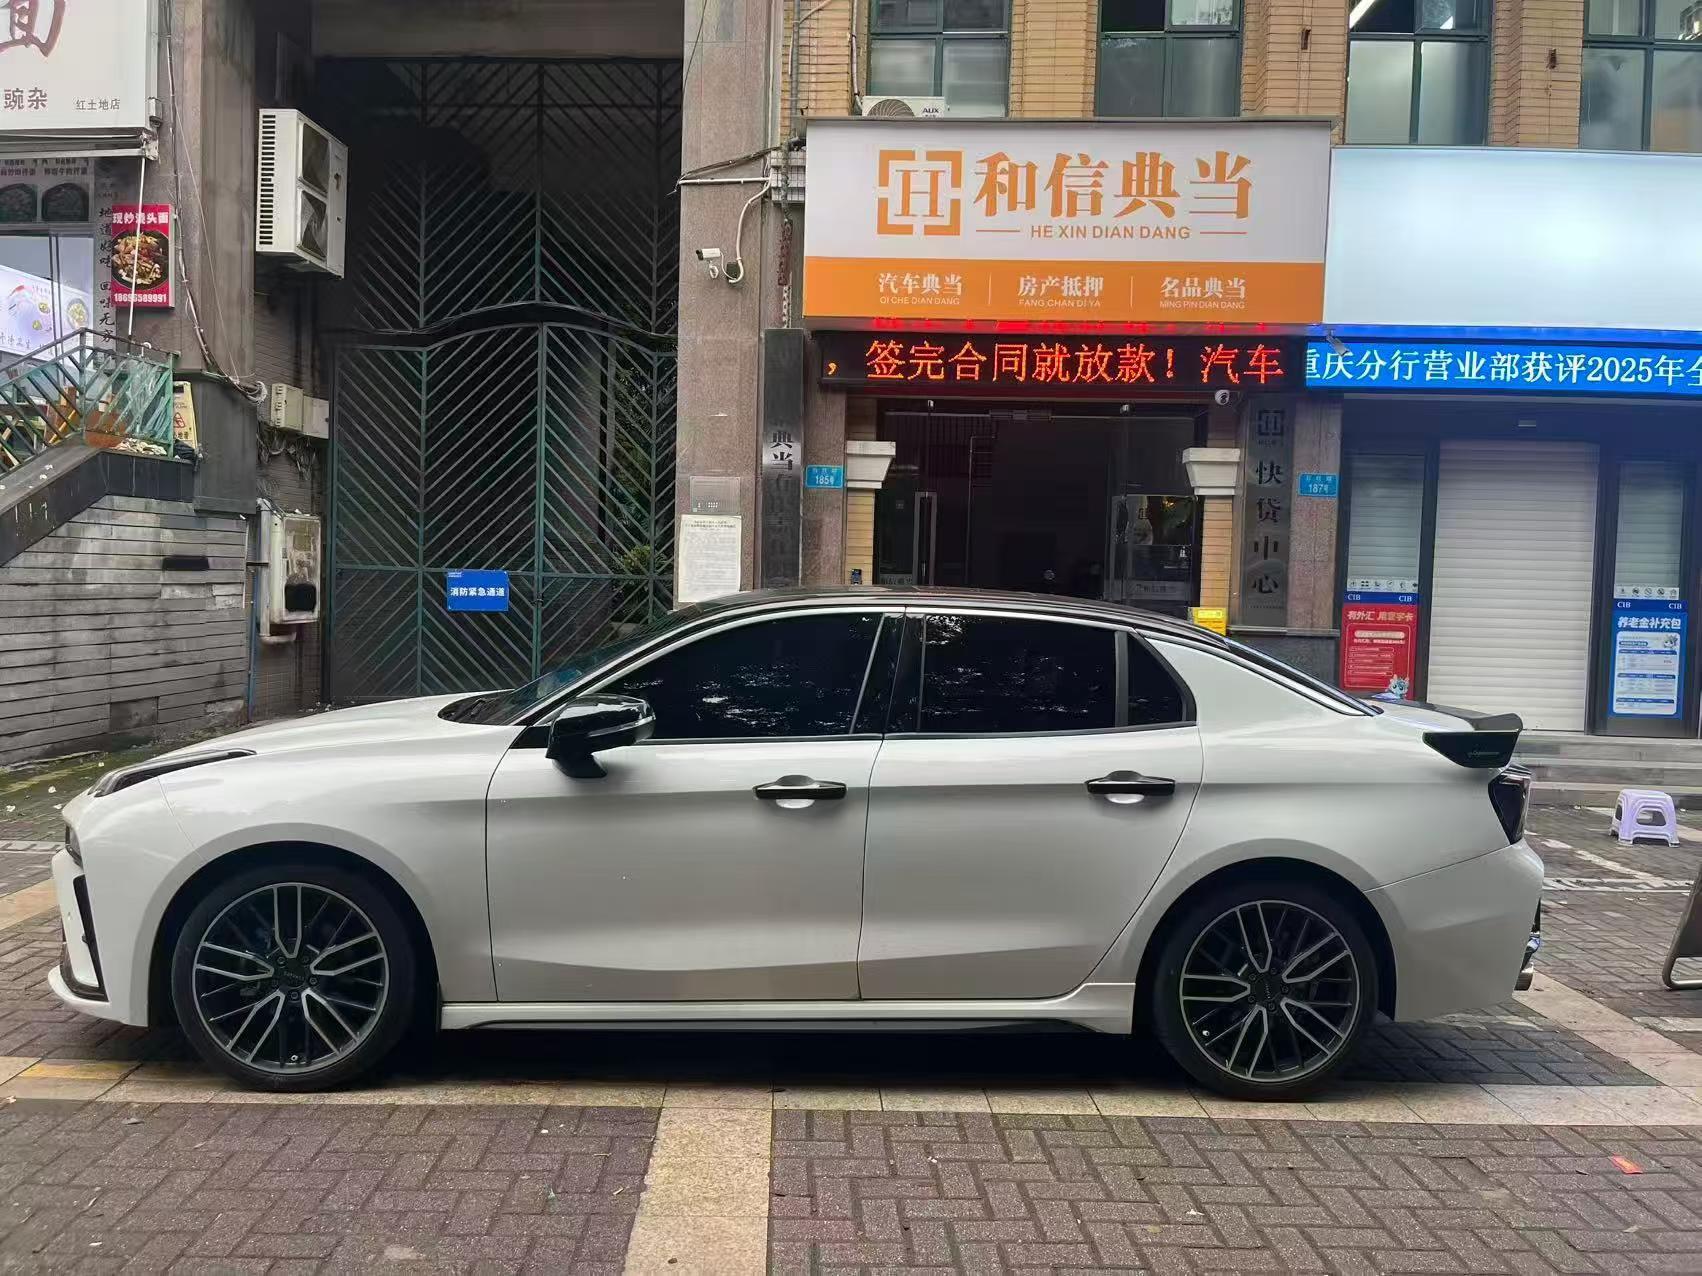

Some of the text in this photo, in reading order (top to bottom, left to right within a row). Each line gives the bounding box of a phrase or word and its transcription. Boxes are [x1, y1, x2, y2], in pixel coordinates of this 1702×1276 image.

[4, 87, 48, 110] 豌杂
[76, 98, 121, 111] 红土地店
[974, 151, 1252, 219] 和信典当
[1031, 225, 1191, 240] HE XIN DIAN DANG
[879, 272, 962, 295] 汽车典当
[1017, 275, 1104, 297] 房产抵押
[1160, 276, 1246, 299] 名品典当
[891, 296, 909, 304] CHE
[934, 297, 960, 305] DANG
[1159, 300, 1181, 309] MING
[1220, 301, 1245, 310] DANG
[1253, 460, 1284, 594] 快贷中心
[450, 587, 505, 597] 消防紧急通道
[1617, 616, 1682, 630] 养老金补充包
